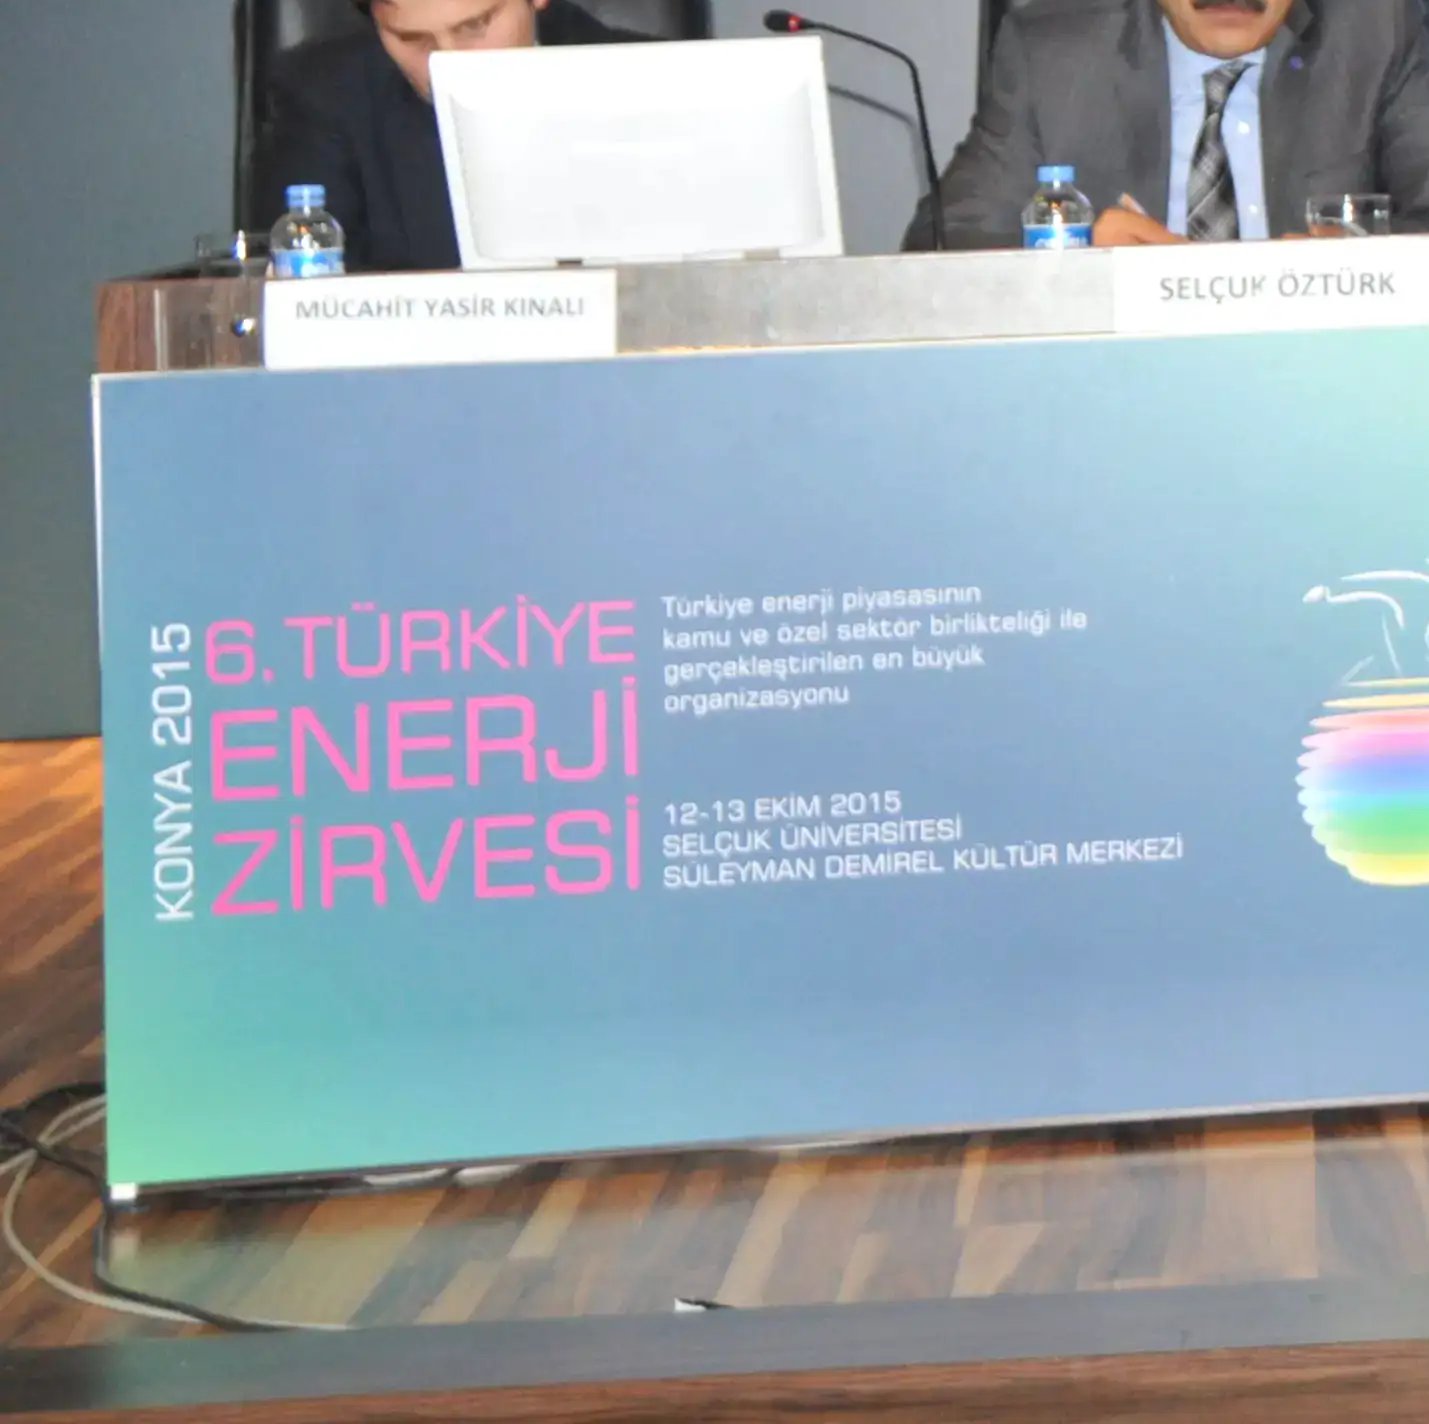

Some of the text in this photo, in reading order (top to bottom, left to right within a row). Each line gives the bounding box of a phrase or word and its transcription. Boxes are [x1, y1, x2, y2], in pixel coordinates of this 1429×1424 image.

[296, 291, 584, 321] MÜCAHİT YASİR KINALI
[1159, 267, 1396, 304] SELÇUK ÖZTÜRK
[661, 585, 981, 619] Türkiye enerji piyasasının
[662, 608, 1087, 649] kamu ve özel sektör birlikteliği ile
[663, 645, 985, 687] gerçekleştirilen en büyük
[664, 685, 850, 717] organizasyonu
[210, 676, 639, 801] ENERJİ
[152, 621, 195, 921] KONYA 2015
[663, 791, 902, 826] 12-13 EKİM 2015
[211, 795, 641, 915] ZİRVESİ
[663, 813, 962, 859] SELÇUK ÜNİVERSİTESİ
[663, 832, 1184, 889] SÜLEYMAN DEMİREL KÜLTÜR MERKEZİ
